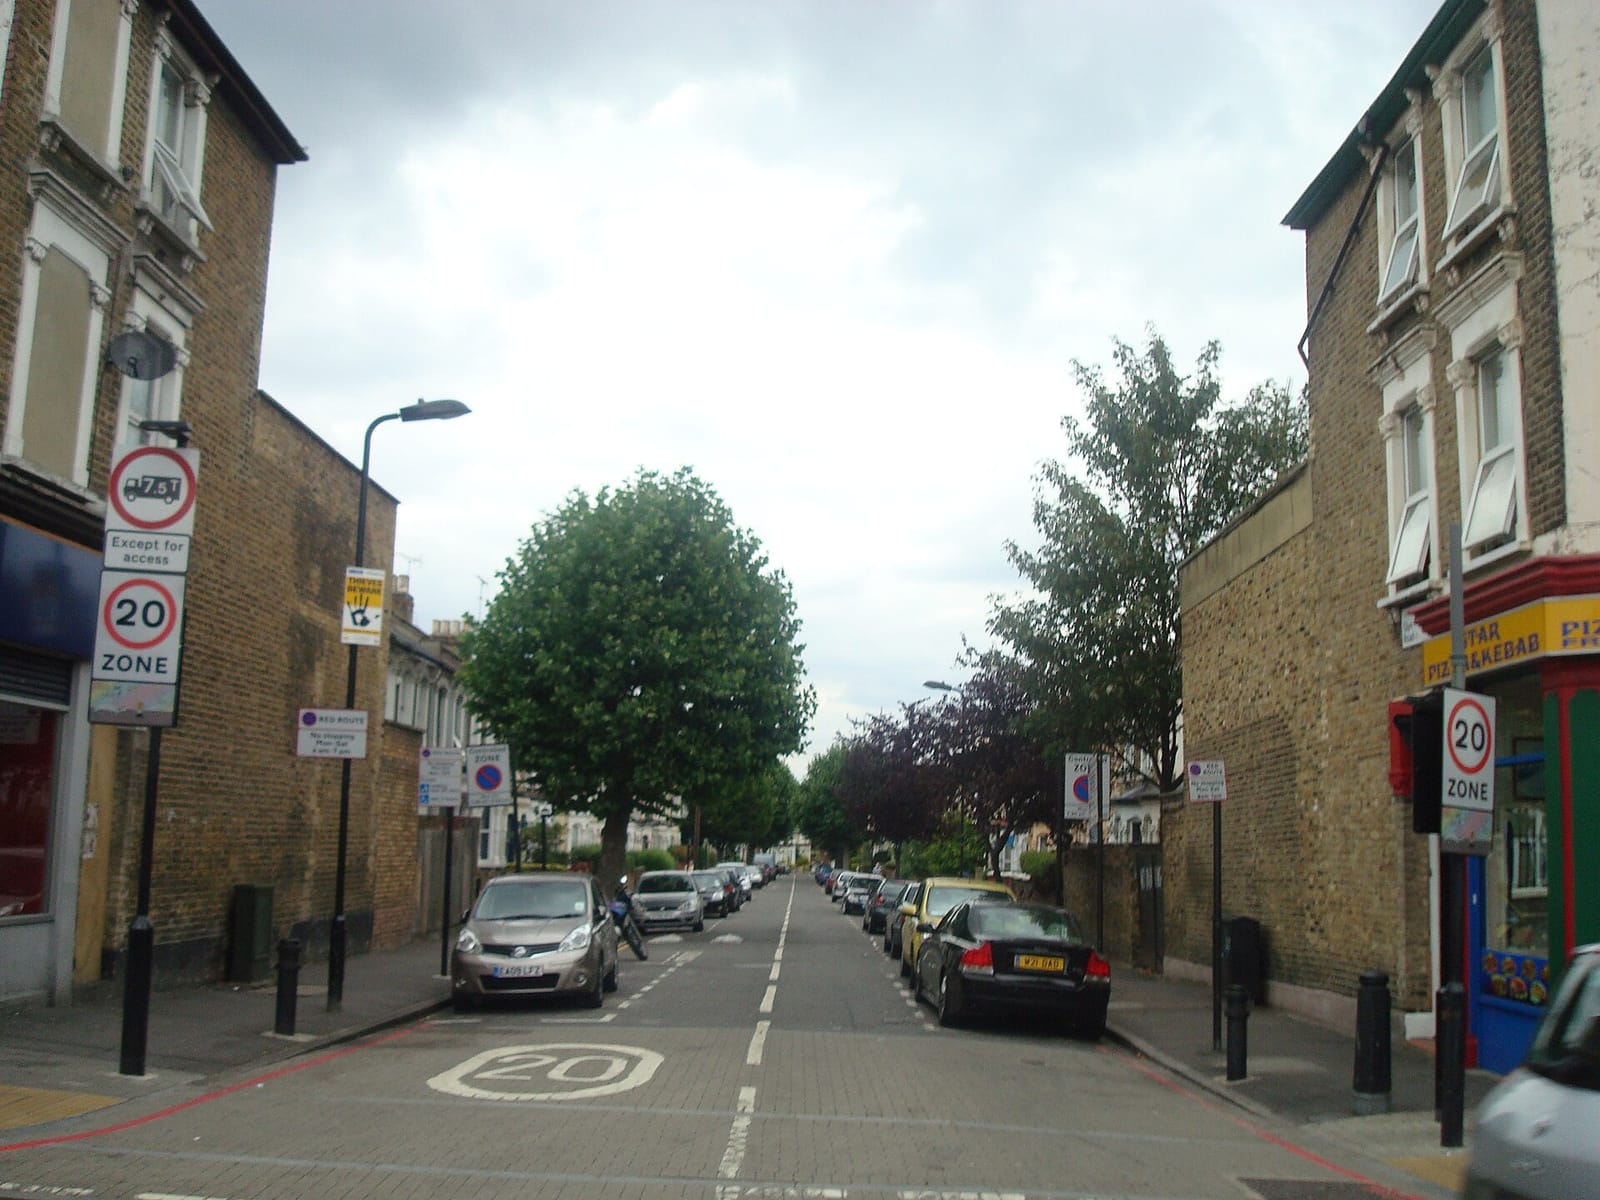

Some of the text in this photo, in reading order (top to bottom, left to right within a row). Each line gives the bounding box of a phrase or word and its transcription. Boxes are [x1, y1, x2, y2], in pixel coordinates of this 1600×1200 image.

[112, 537, 184, 551] Except for
[124, 553, 169, 565] access
[115, 598, 166, 628] 20
[102, 653, 168, 674] ZONE
[1455, 720, 1486, 752] 20
[475, 754, 500, 763] ZONE
[1448, 778, 1489, 801] ZONE
[472, 1053, 628, 1082] 20
